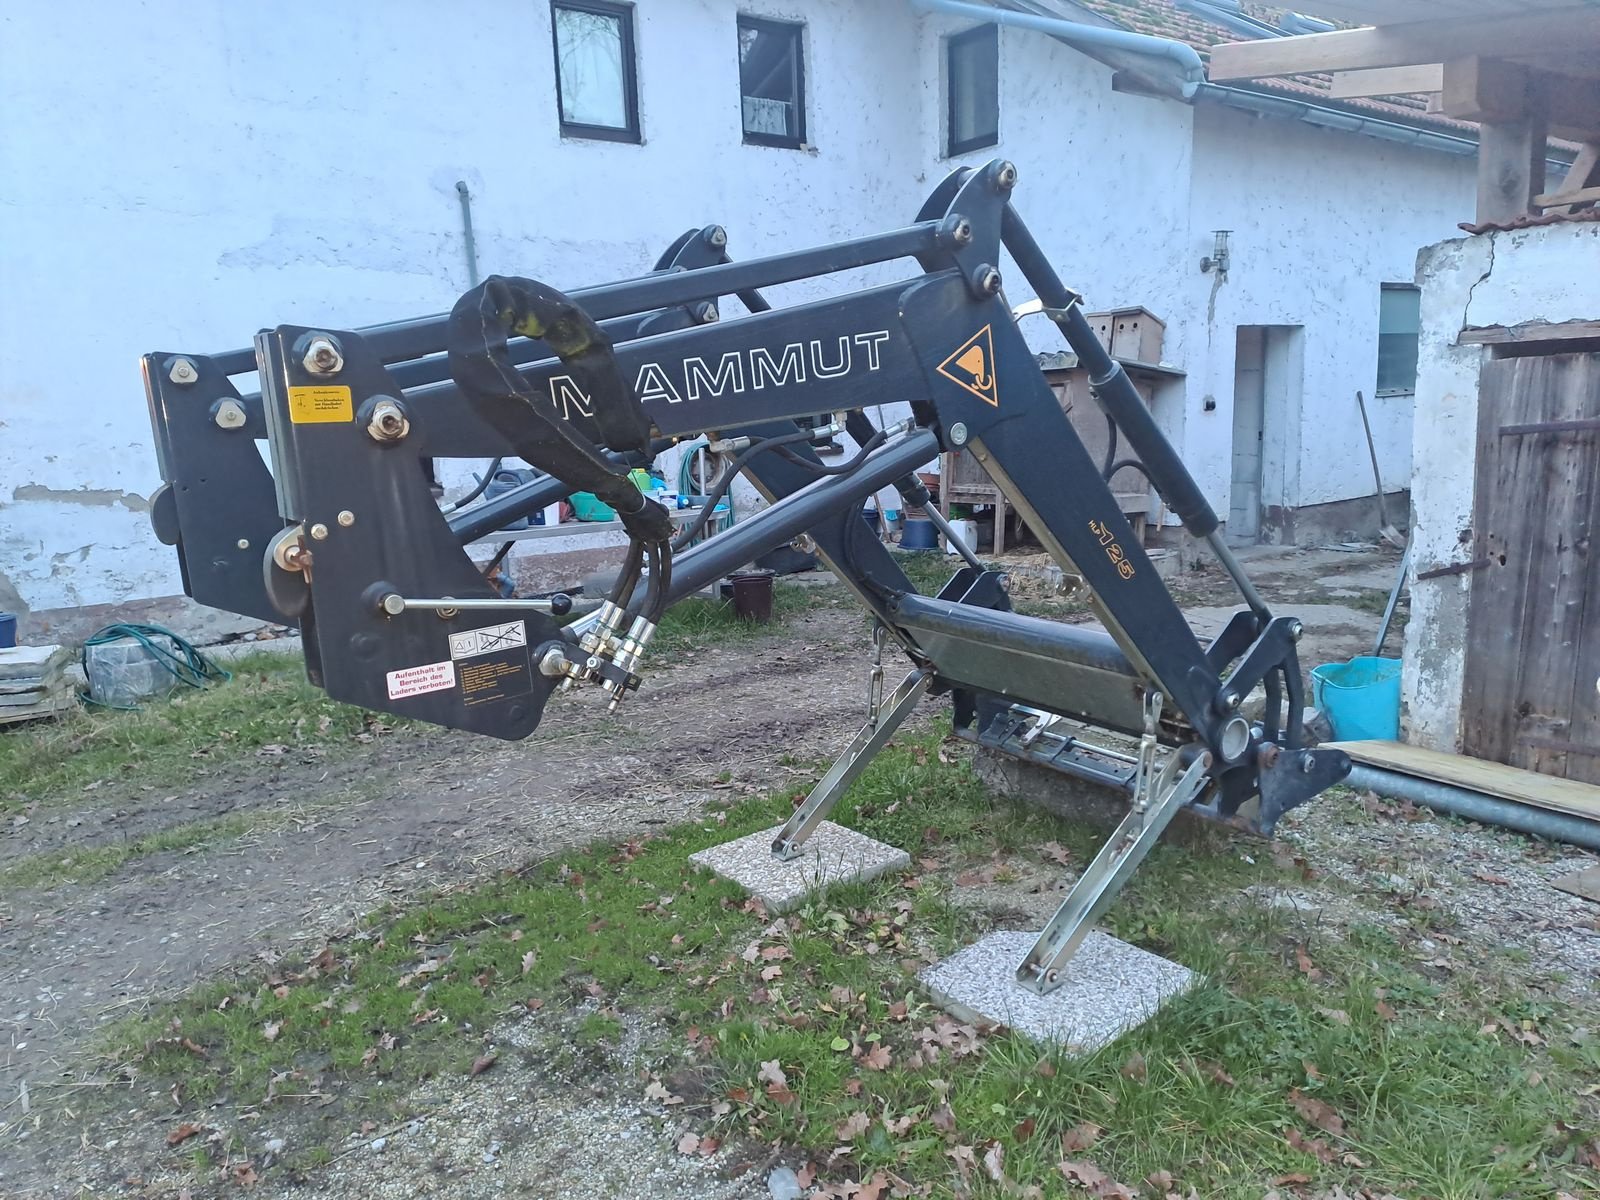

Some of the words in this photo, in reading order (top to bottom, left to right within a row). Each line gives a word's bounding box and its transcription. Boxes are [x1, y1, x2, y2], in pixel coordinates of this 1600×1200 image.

[549, 330, 889, 420] MAMMUT
[1099, 521, 1135, 579] 125
[395, 666, 435, 679] Aufenthalt
[400, 676, 428, 686] Bereich
[430, 673, 443, 681] des
[390, 686, 416, 696] Laders
[418, 679, 453, 691] verboten!
